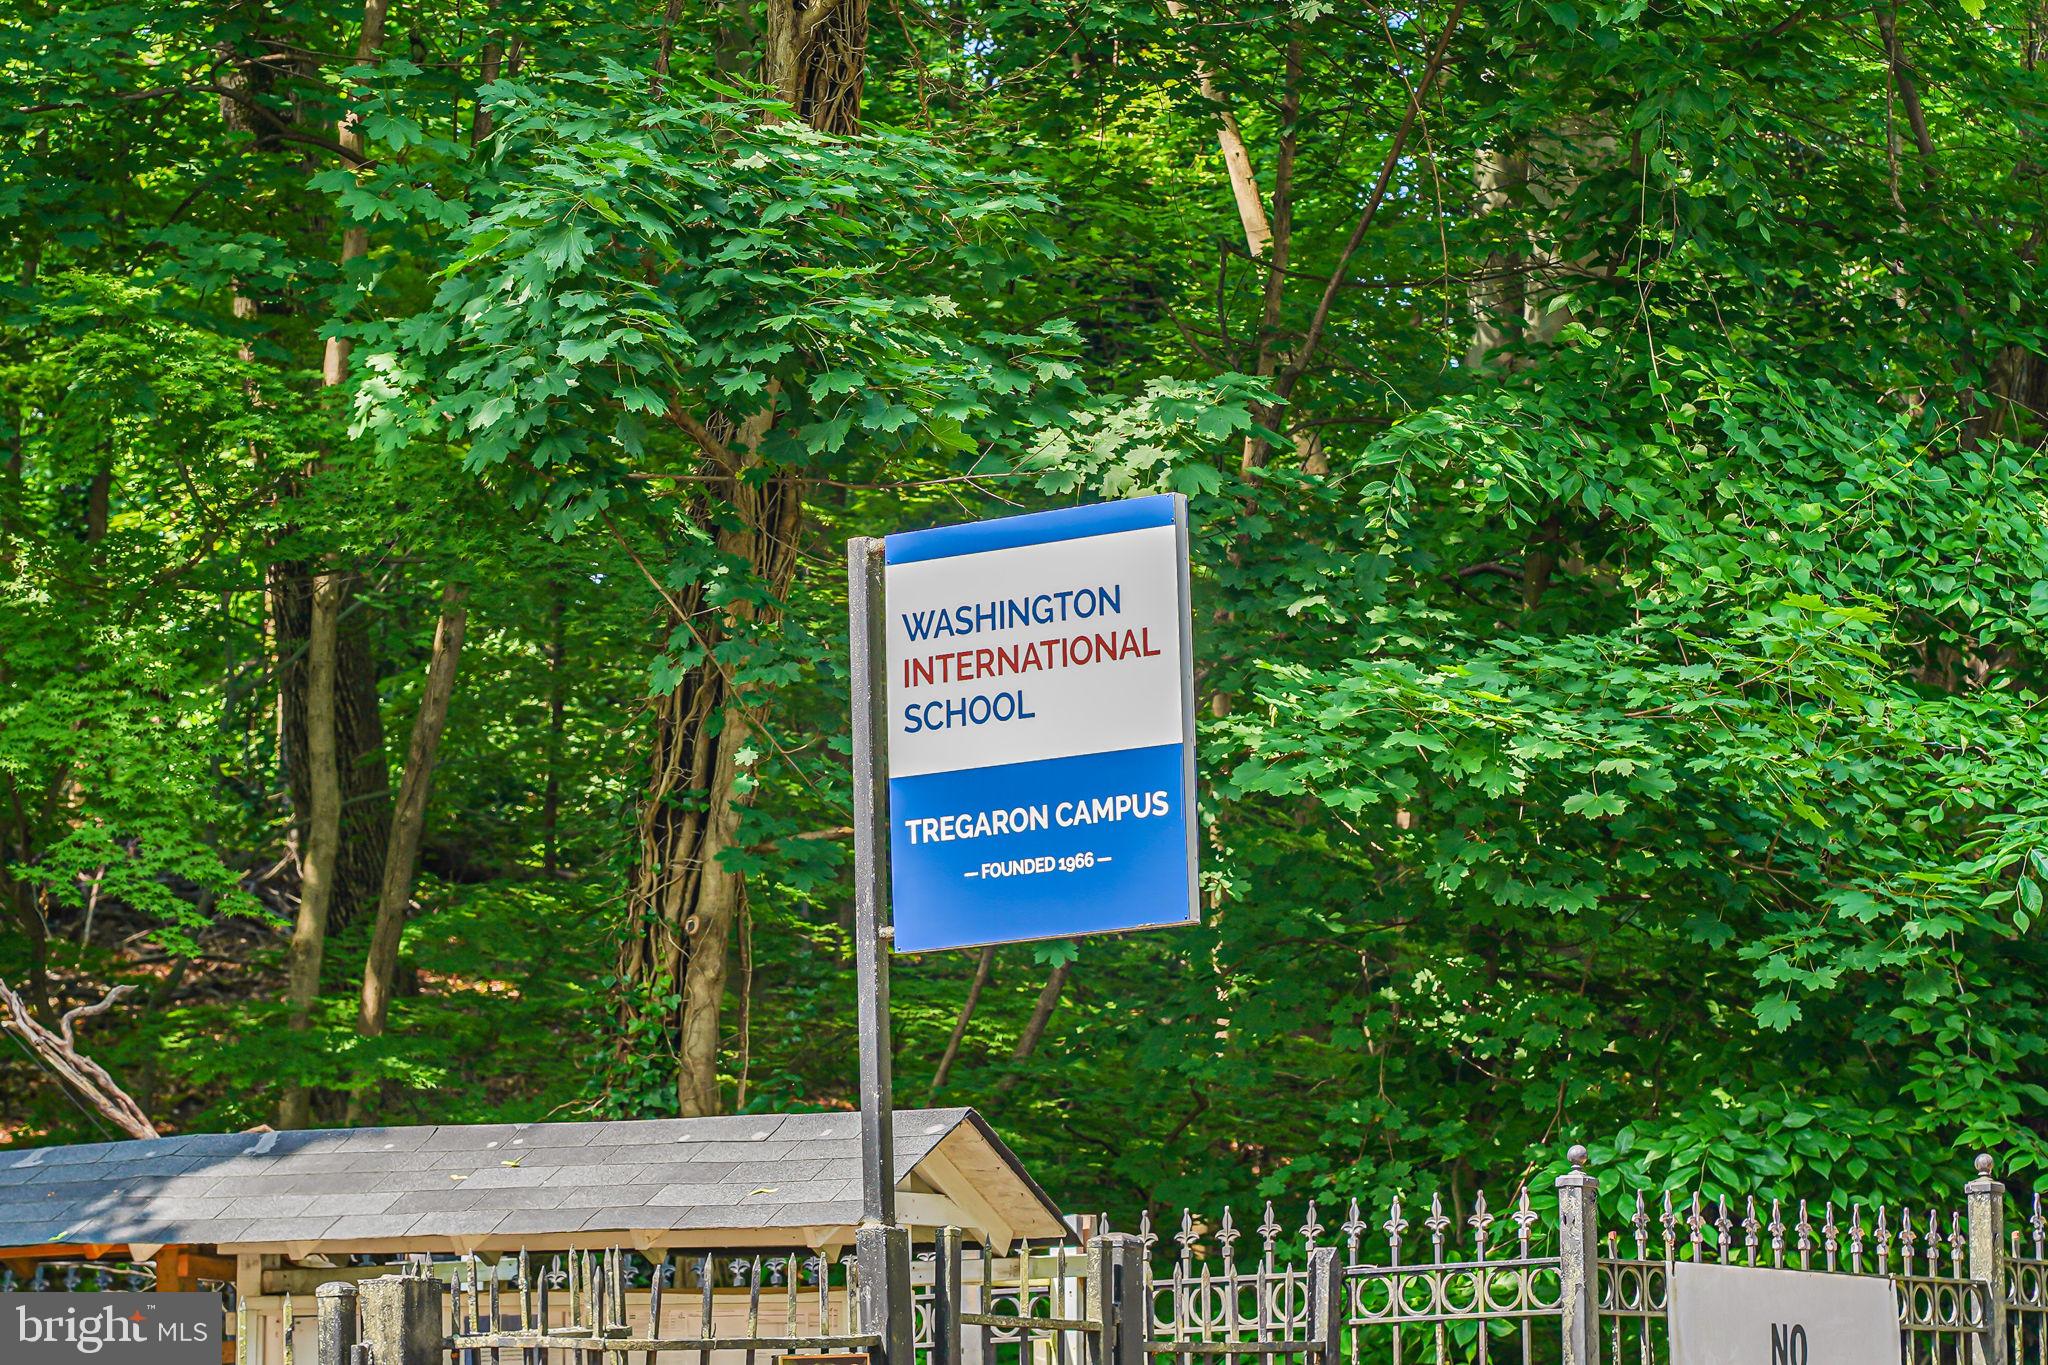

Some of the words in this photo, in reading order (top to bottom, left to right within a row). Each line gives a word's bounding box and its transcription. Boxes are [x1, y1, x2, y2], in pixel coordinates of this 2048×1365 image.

[902, 584, 1121, 641] WASHINGTON
[904, 627, 1161, 688] INTERNATIONAL
[904, 690, 1035, 733] SCHOOL
[905, 805, 1049, 844] TREGARON
[1056, 790, 1169, 828] CAMPUS
[982, 856, 1056, 879] FOUNDED
[1059, 852, 1095, 874] 1966
[1771, 1323, 1808, 1365] NO
